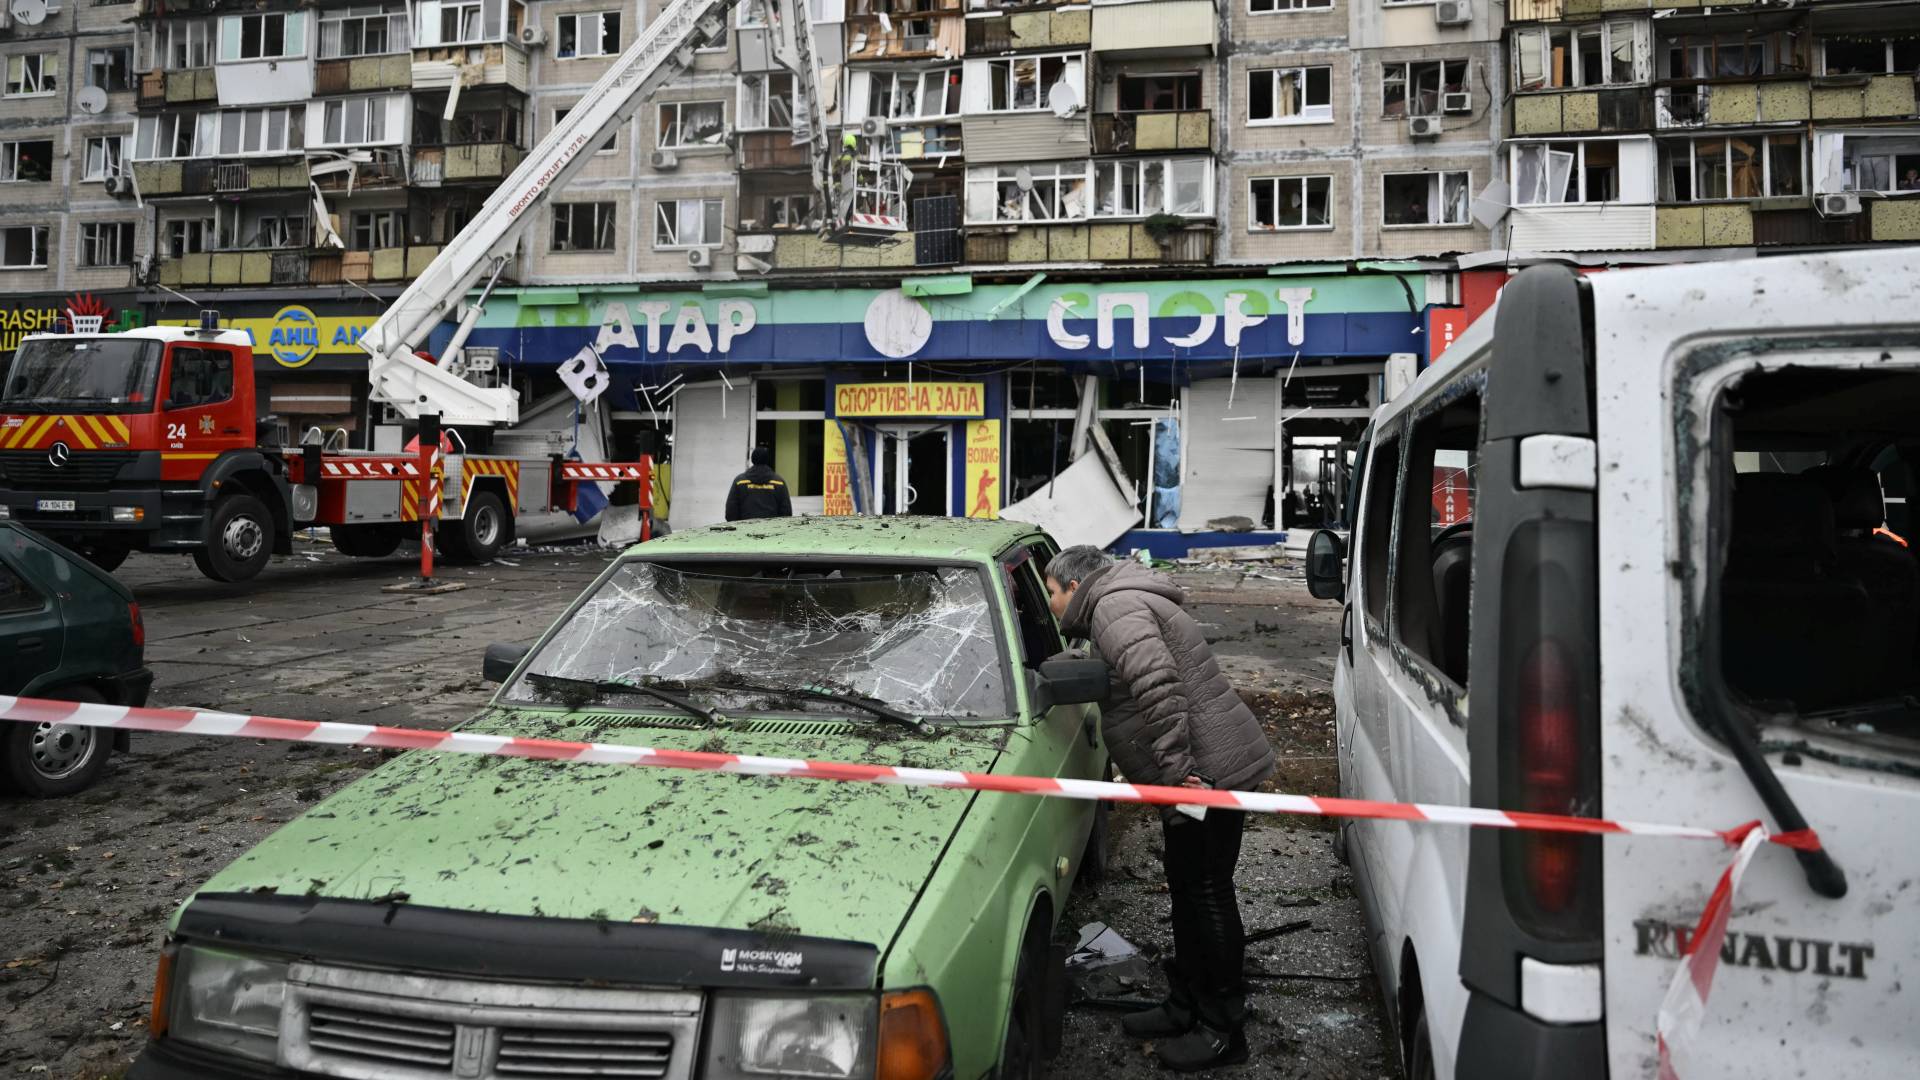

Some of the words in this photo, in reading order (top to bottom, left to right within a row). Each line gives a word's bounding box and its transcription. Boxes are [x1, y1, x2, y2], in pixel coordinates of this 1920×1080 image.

[509, 186, 539, 216] BRONTO
[537, 157, 565, 187] SKYLIFT
[269, 328, 319, 348] АНЦ
[838, 385, 931, 413] СПОРТИВНА
[936, 385, 980, 413] ЗАЛА
[167, 423, 187, 440] 24
[967, 447, 999, 464] BOXING
